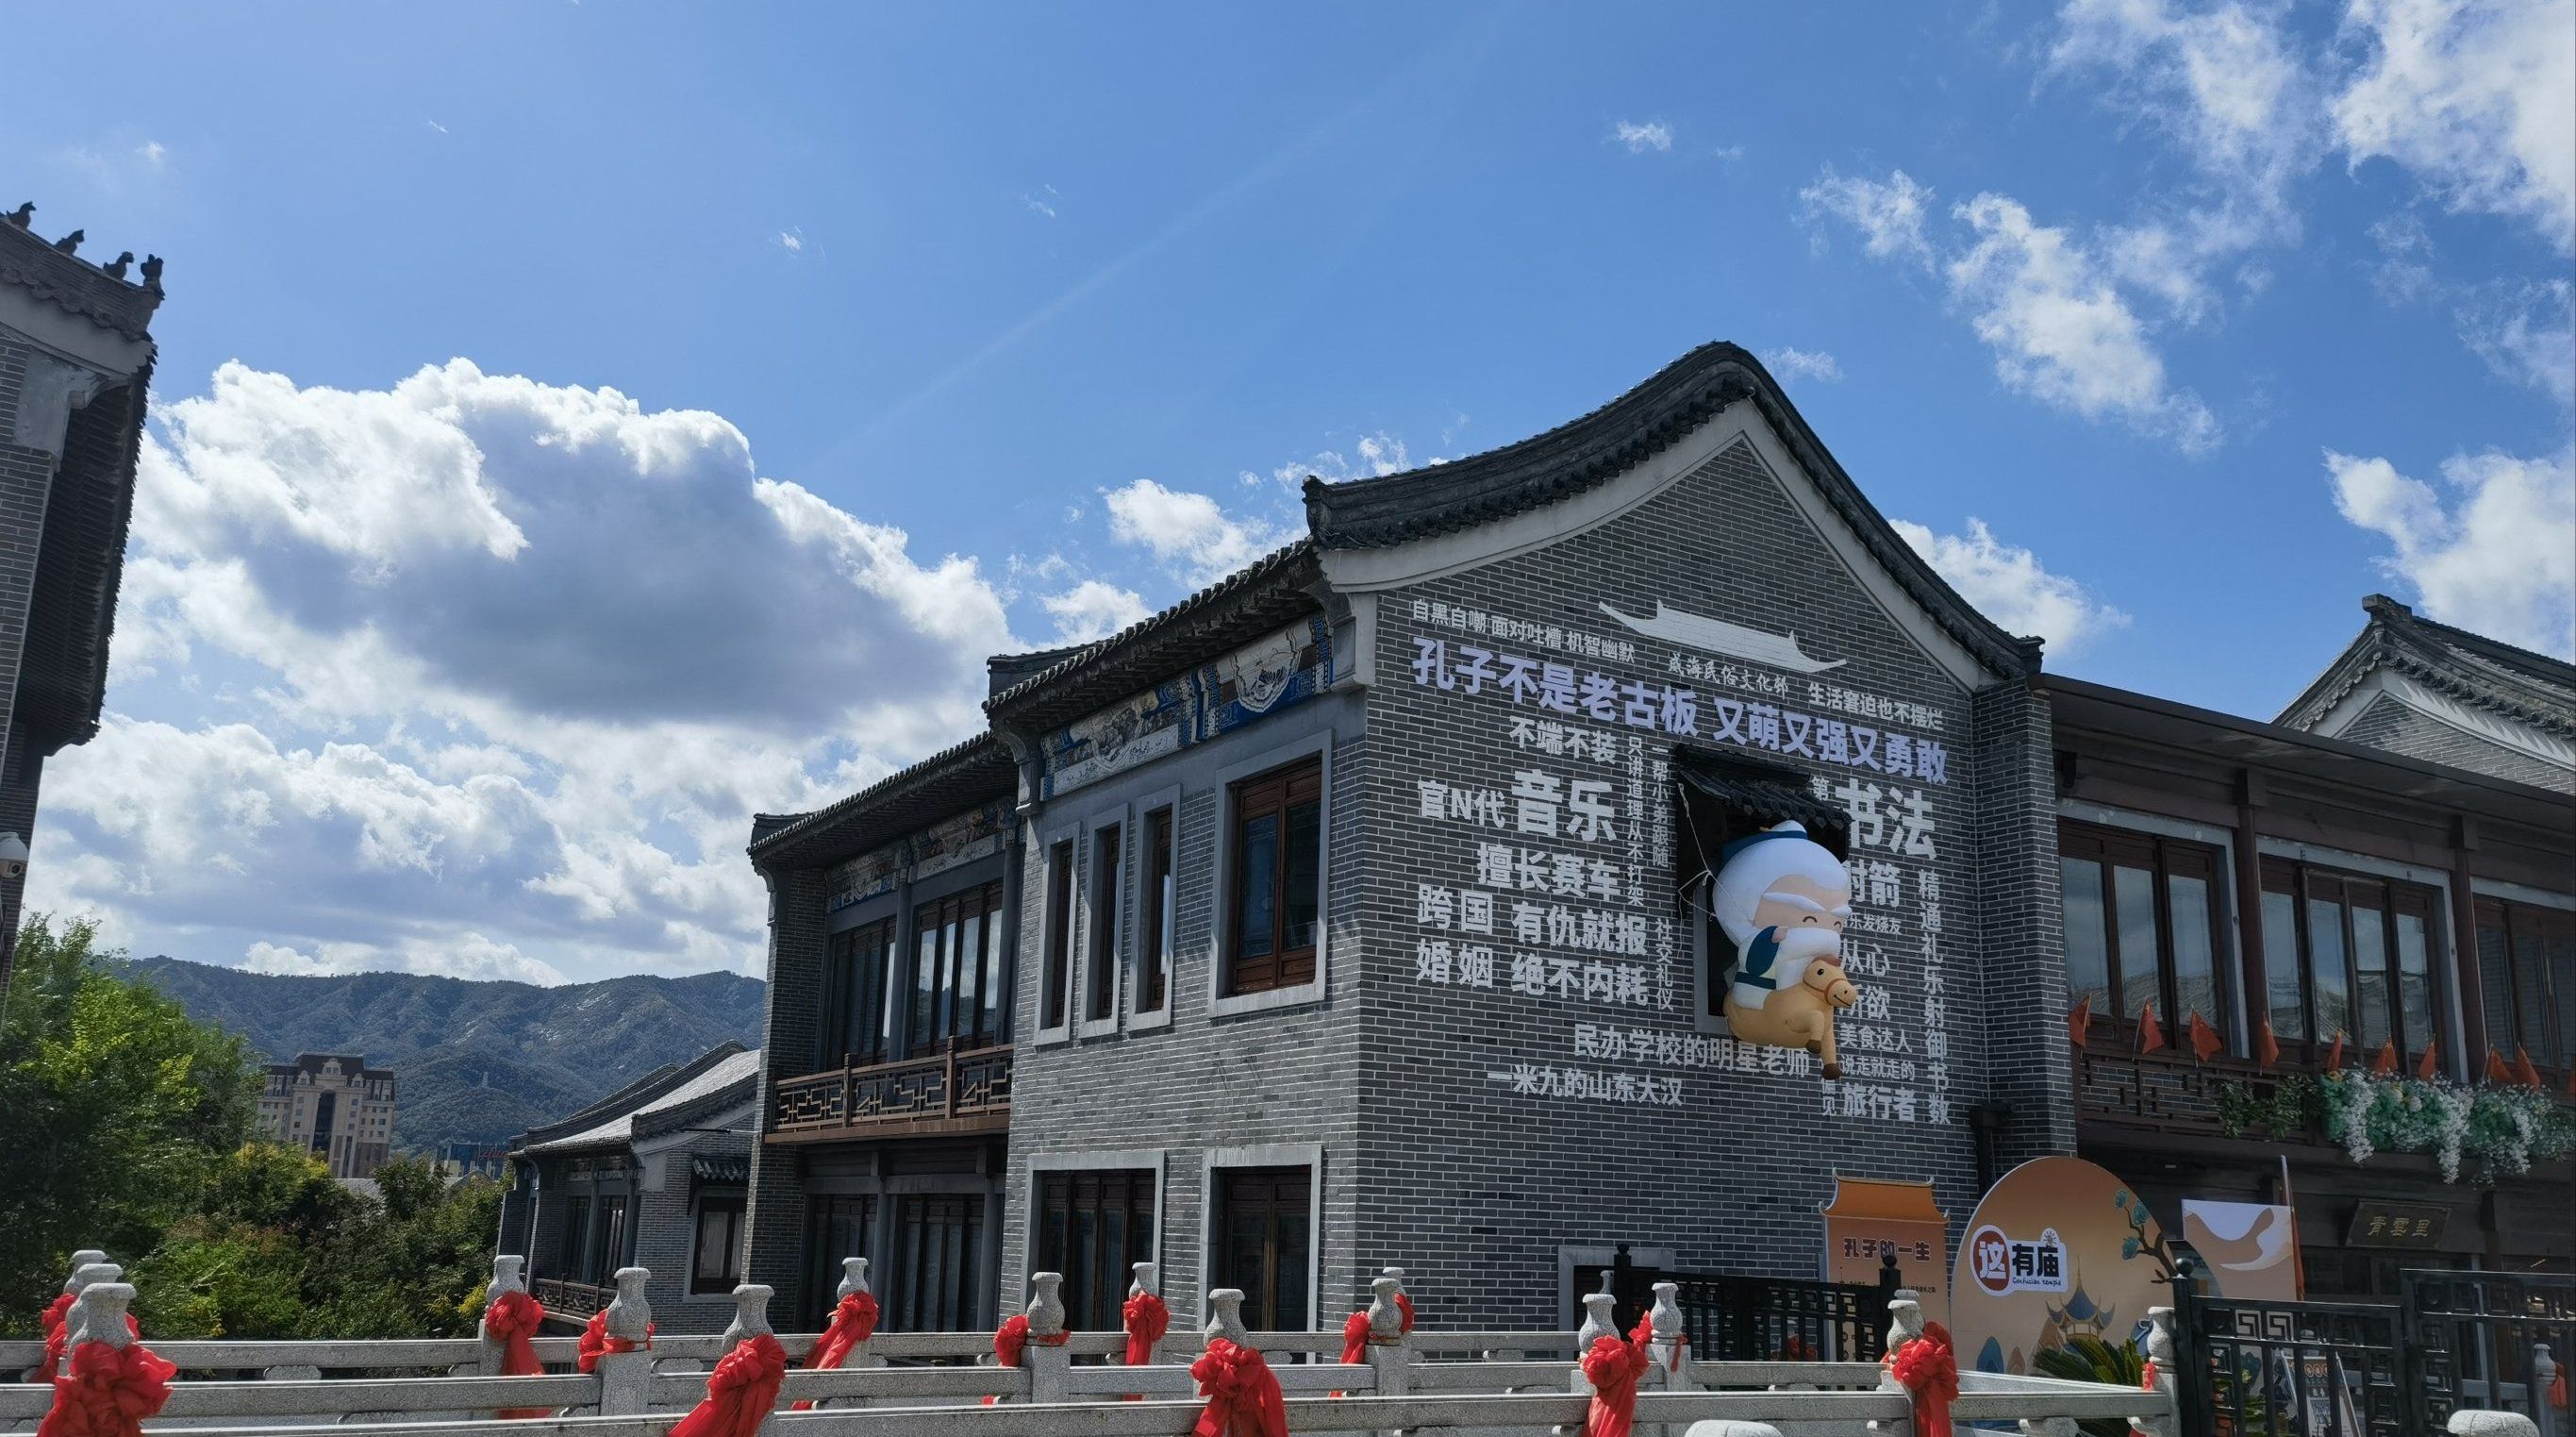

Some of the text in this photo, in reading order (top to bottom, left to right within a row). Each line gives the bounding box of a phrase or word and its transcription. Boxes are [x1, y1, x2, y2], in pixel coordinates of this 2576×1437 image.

[1413, 599, 1636, 663] 自黑自嘲 面对吐槽 机智幽默
[1412, 636, 1949, 785] 孔子不是老古板 又萌又强又勇敢
[1807, 681, 1944, 731] 生活窘迫也不摆烂
[1509, 715, 1617, 765] 不端不装
[1417, 779, 1506, 828] 官N代
[1511, 769, 1617, 842] 音乐
[1626, 735, 1644, 907] 只讲道理从不打架
[1652, 746, 1669, 868] 一帮小弟跟随
[1836, 777, 1936, 861] 书法
[1477, 842, 1620, 903] 擅长赛车
[1417, 884, 1493, 936] 跨国
[1511, 900, 1647, 956] 有仇就报
[1844, 912, 1903, 935] 乐发烧友
[1416, 938, 1493, 989] 婚姻
[1511, 951, 1648, 1007] 绝不内耗
[1654, 917, 1674, 1012] 社交礼仪
[1840, 938, 1890, 977] 从心
[1919, 869, 1951, 1126] 精通礼乐射御书数
[1573, 1024, 1810, 1078] 民办学校的明星老师
[1839, 1022, 1913, 1053] 美食达人
[1487, 1062, 1683, 1108] 一米九的山东大汉
[1840, 1055, 1916, 1081] 说走就走的
[1841, 1082, 1918, 1123] 旅行者
[1843, 1237, 1931, 1262] 孔子的一生
[1978, 1240, 2060, 1279] 这有庙
